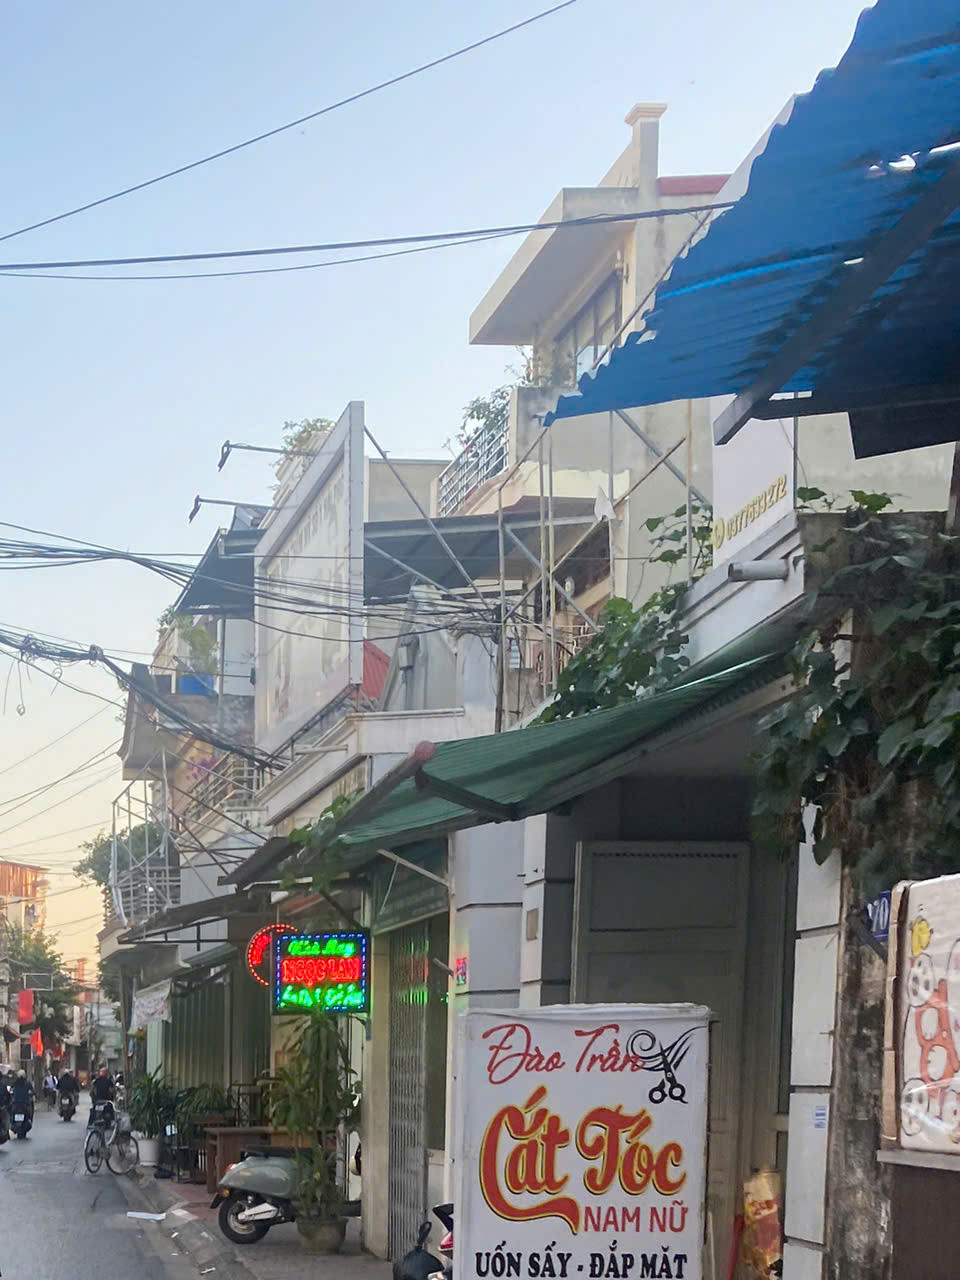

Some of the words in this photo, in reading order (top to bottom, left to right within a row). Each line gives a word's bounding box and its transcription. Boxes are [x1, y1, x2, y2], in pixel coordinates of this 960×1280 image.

[482, 1024, 565, 1085] Đào
[575, 1024, 646, 1073] Trần
[479, 1085, 580, 1236] Cắt
[575, 1105, 688, 1196] Tóc
[584, 1206, 641, 1232] NAM
[649, 1200, 689, 1233] NỮ
[476, 1240, 522, 1278] UỐN
[528, 1240, 573, 1278] SẤY
[589, 1240, 635, 1278] ĐẮP
